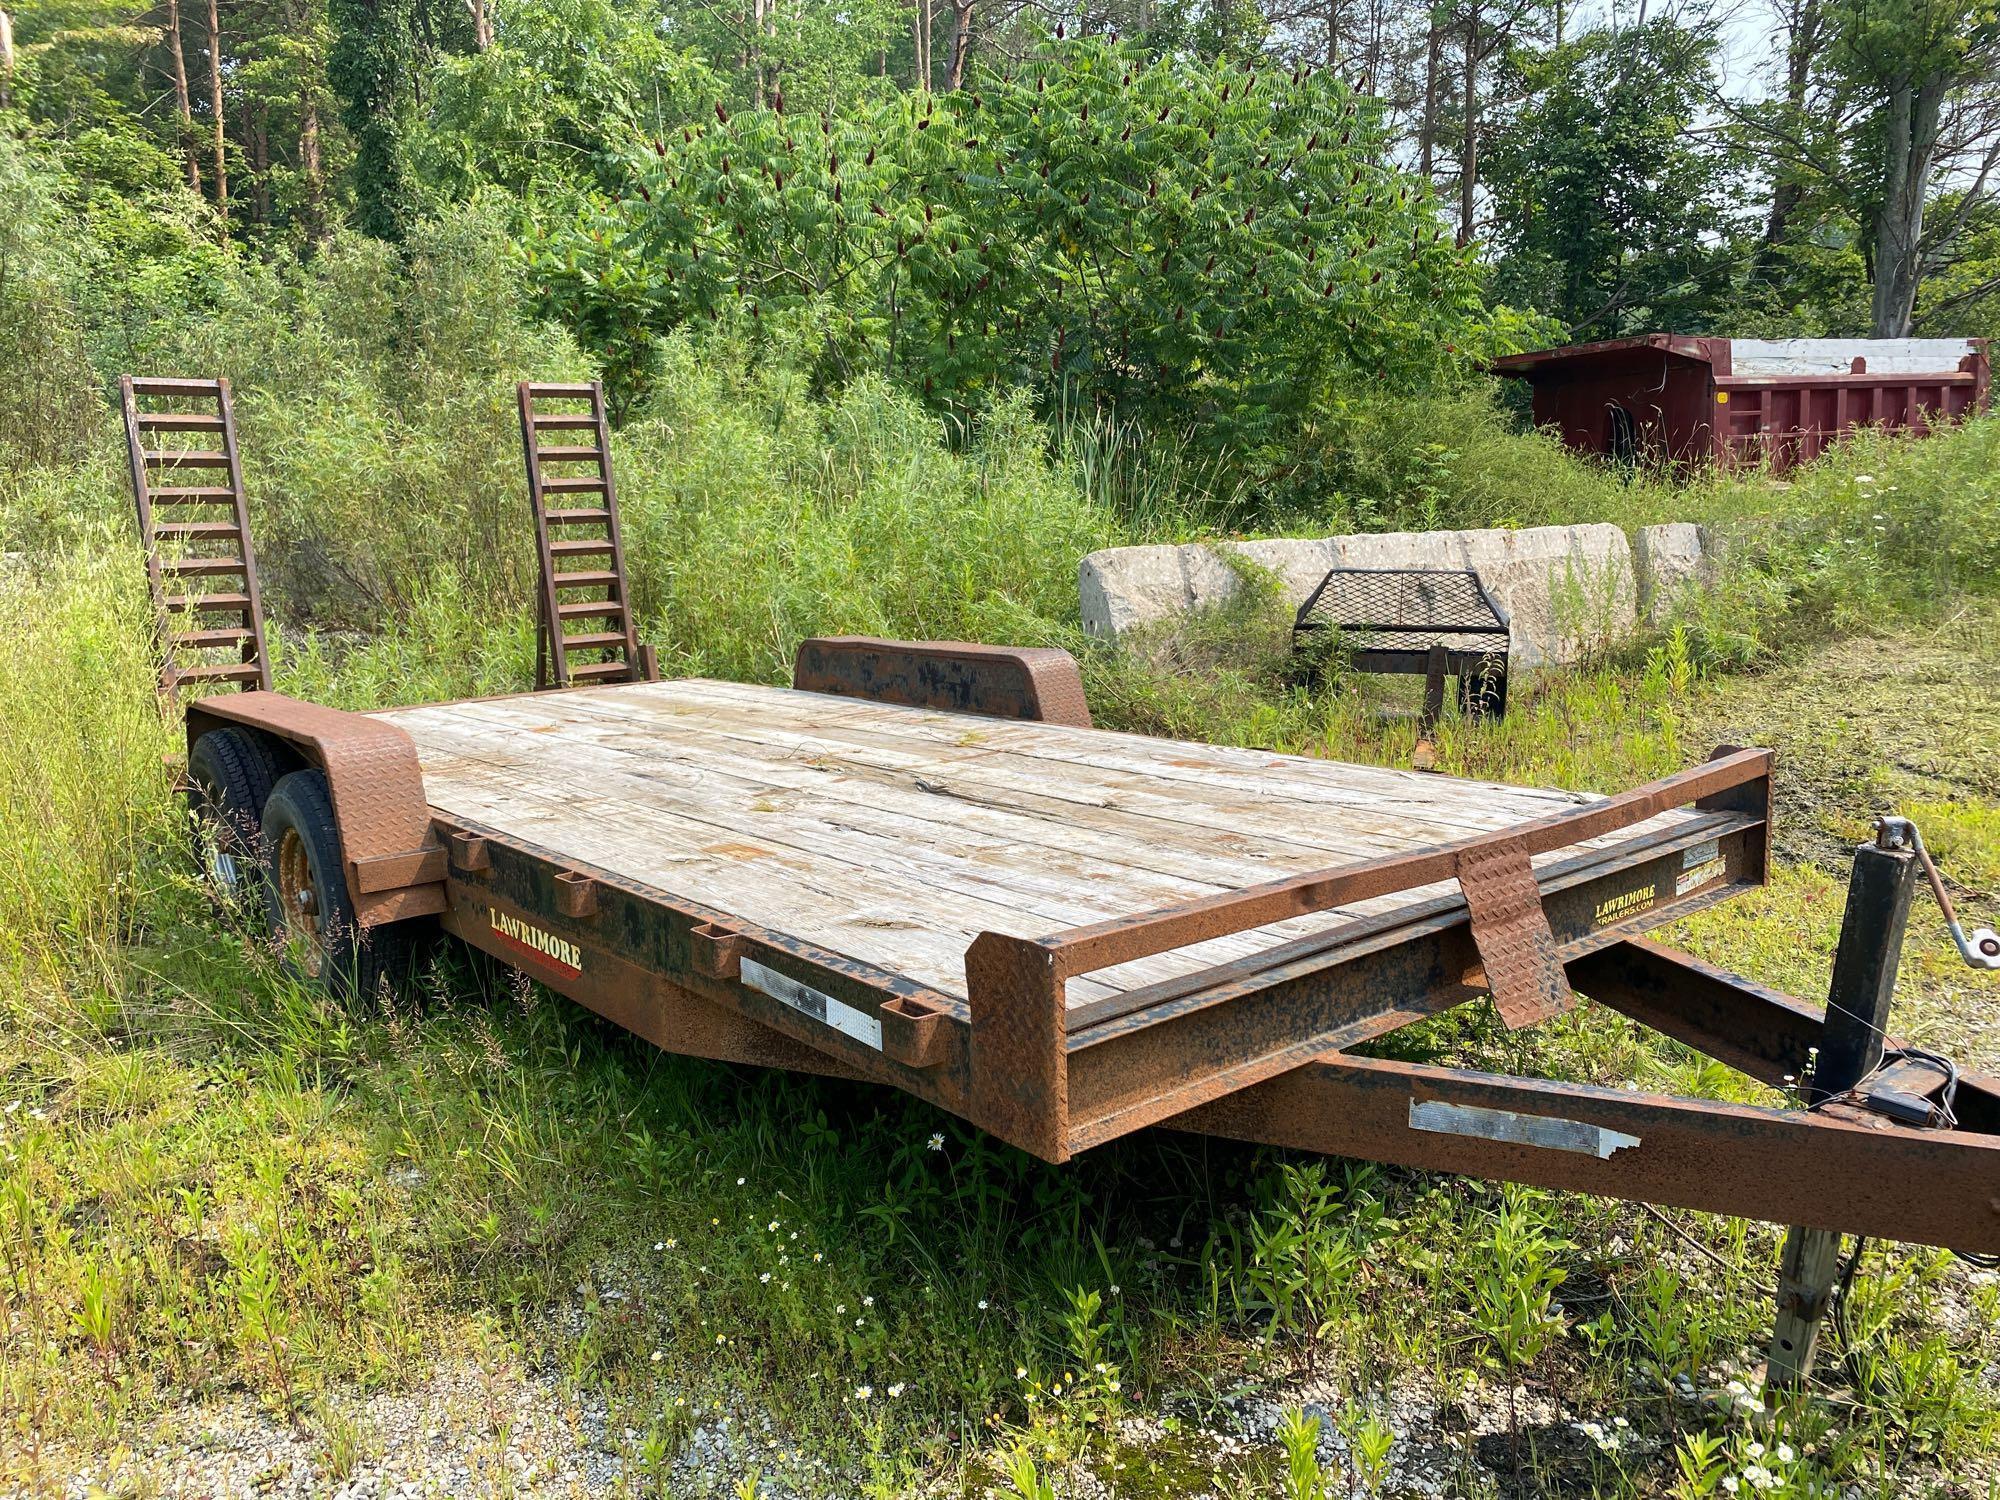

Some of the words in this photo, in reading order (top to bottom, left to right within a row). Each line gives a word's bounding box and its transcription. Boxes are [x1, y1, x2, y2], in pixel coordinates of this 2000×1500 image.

[1595, 884, 1655, 918] LAWRIMORE
[1597, 899, 1654, 926] TRAILERS.COM
[490, 907, 582, 971] LAWRIMORE
